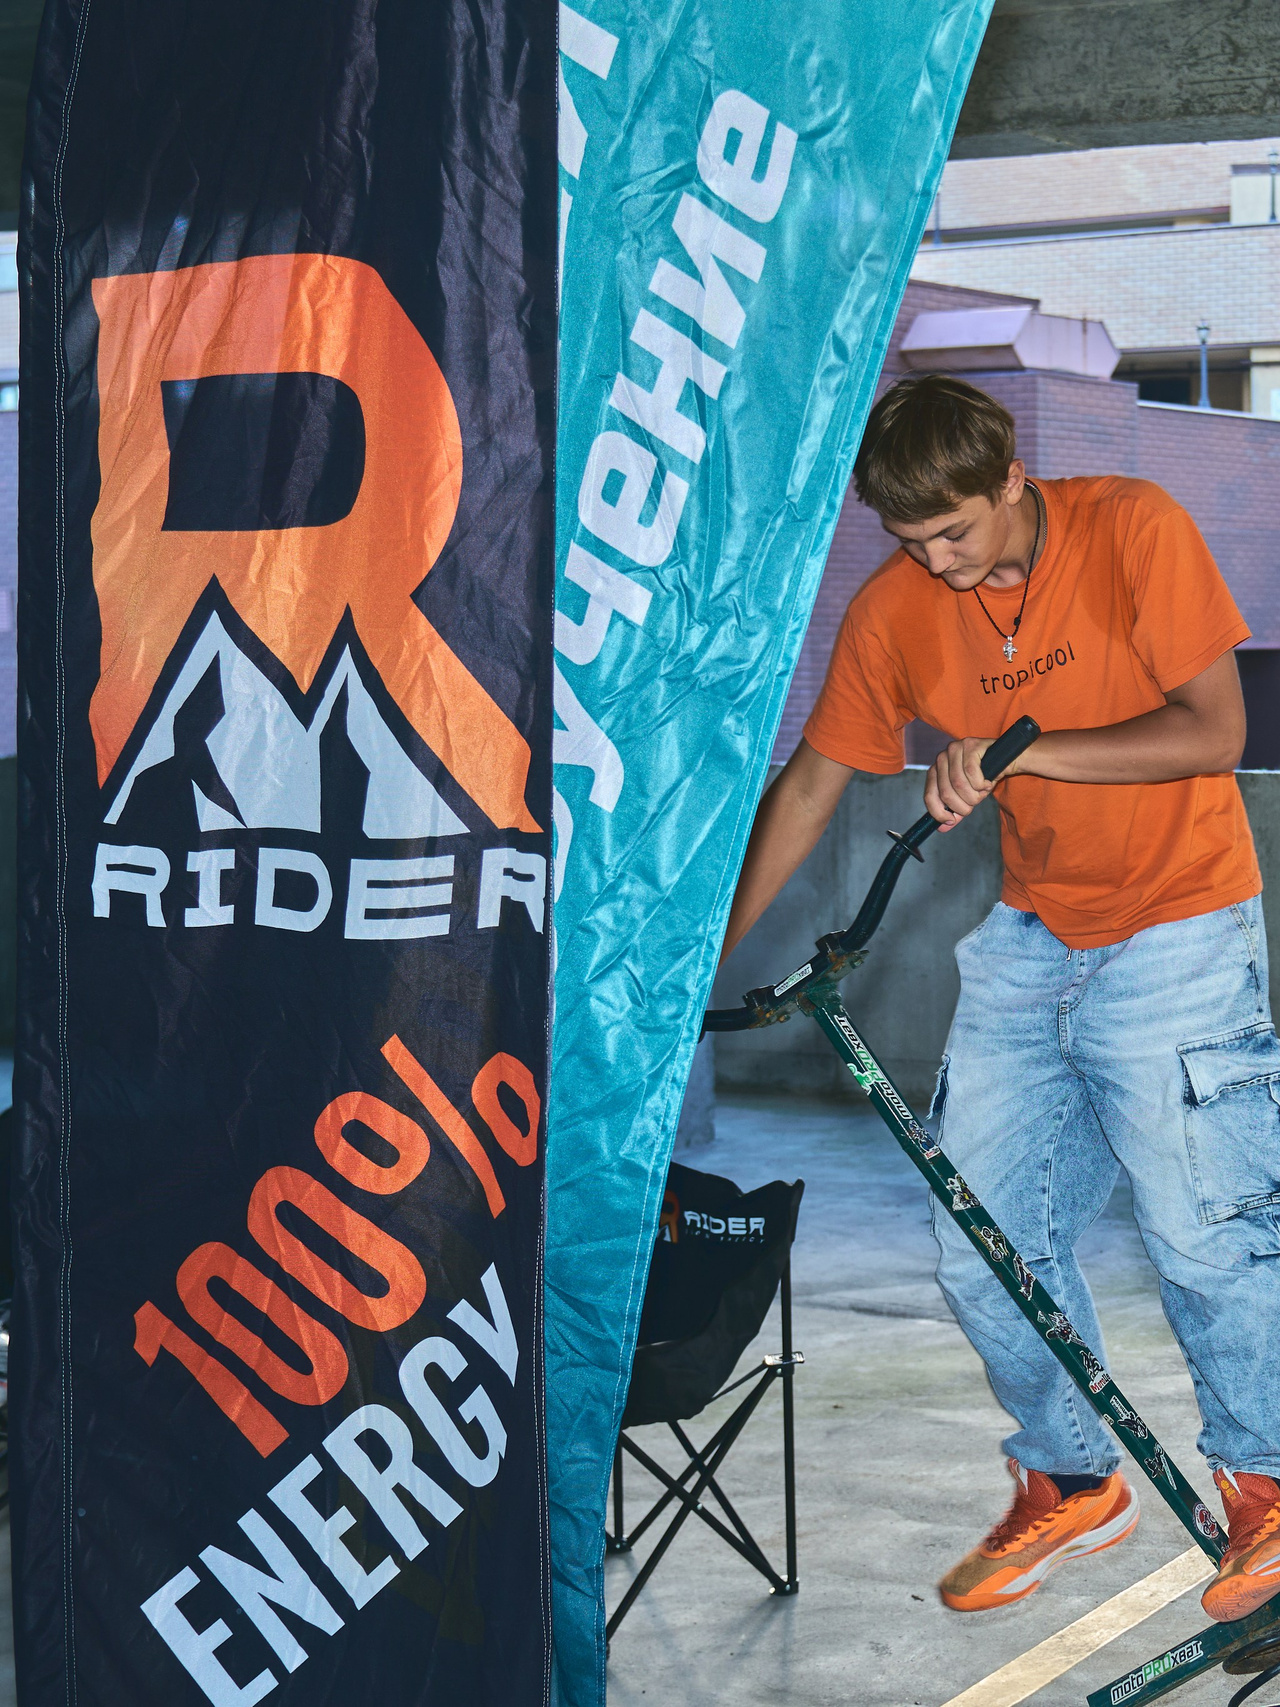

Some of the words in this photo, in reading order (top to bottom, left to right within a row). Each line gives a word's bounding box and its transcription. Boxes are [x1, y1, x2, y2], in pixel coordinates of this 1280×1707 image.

[553, 89, 799, 905] учение
[980, 641, 1075, 694] tropicool
[92, 843, 546, 940] RIDER
[133, 1034, 541, 1458] 100%
[684, 1210, 765, 1236] RIDER
[140, 1262, 519, 1707] ENERGY
